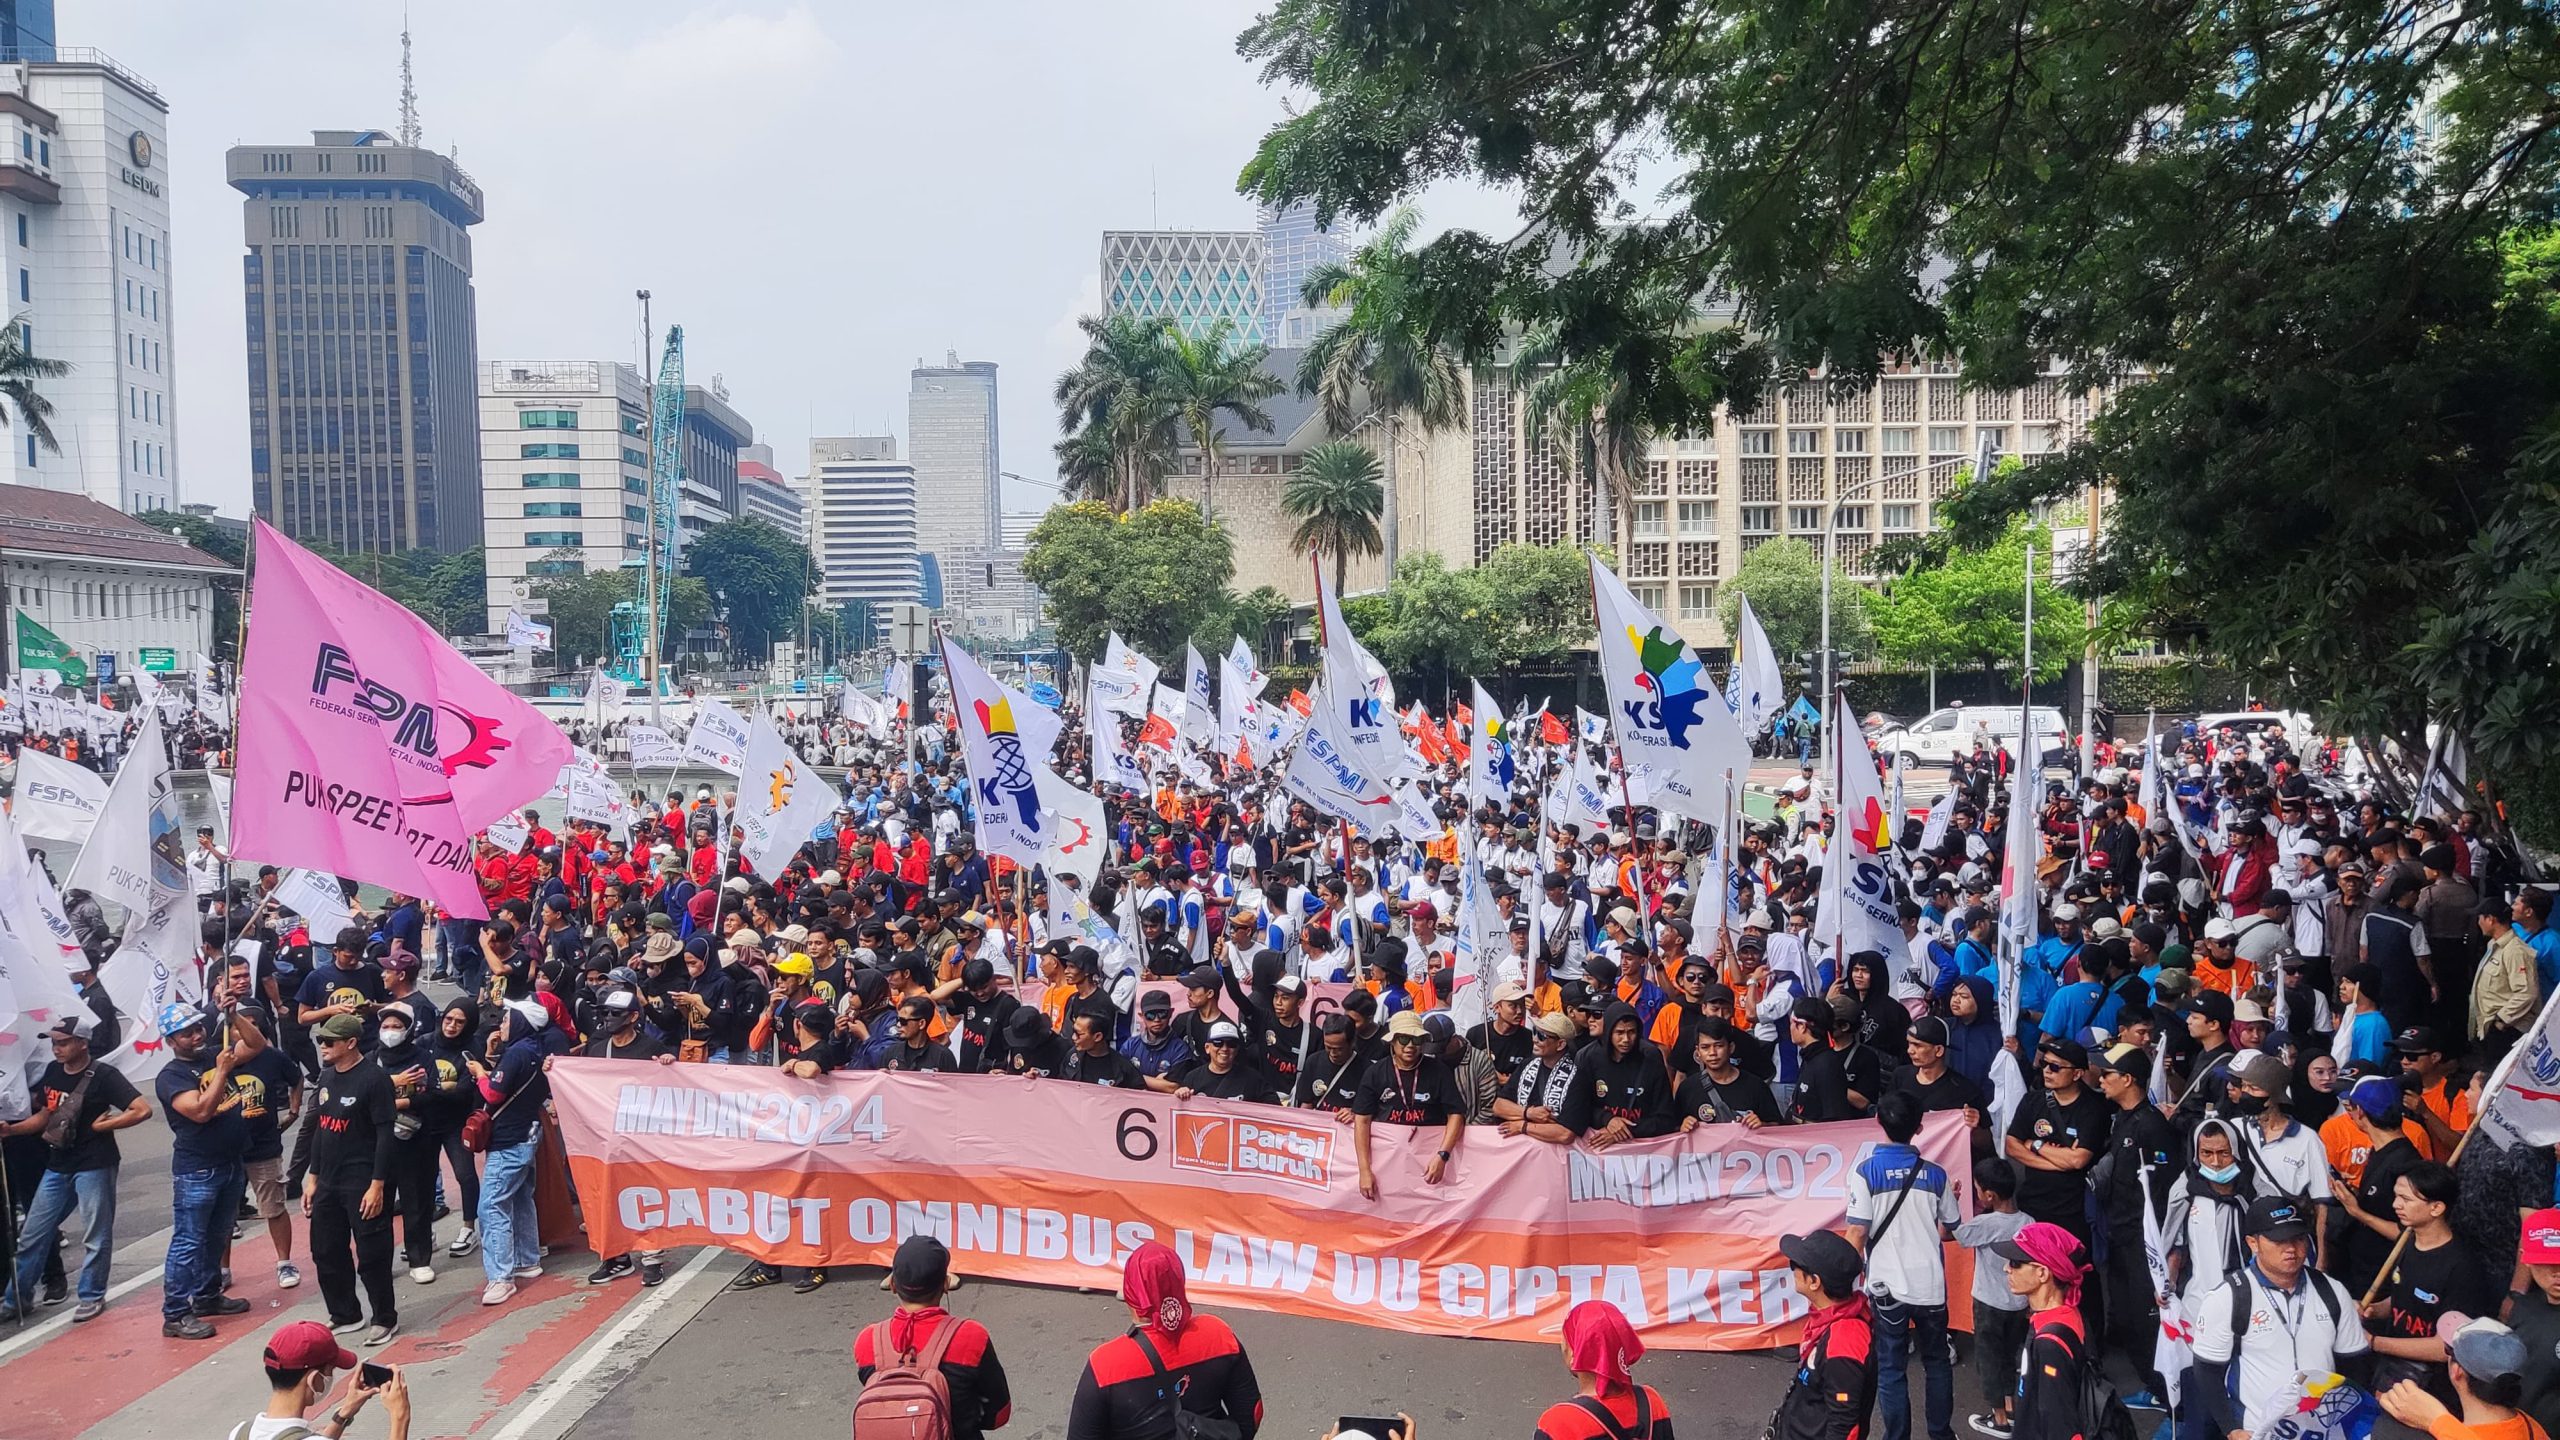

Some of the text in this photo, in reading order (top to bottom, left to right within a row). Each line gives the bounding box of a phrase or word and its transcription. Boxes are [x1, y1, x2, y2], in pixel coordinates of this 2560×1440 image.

[123, 168, 159, 197] ESDM
[309, 697, 356, 718] FEDERASI
[1306, 728, 1369, 794] FSPMI
[106, 865, 136, 890] PUK
[1115, 1107, 1159, 1161] 6
[1239, 1123, 1326, 1159] Partai
[1238, 1146, 1323, 1181] Buruh
[617, 1185, 1809, 1326] CABUT OMNIBUS LAW UU CIPTA KER
